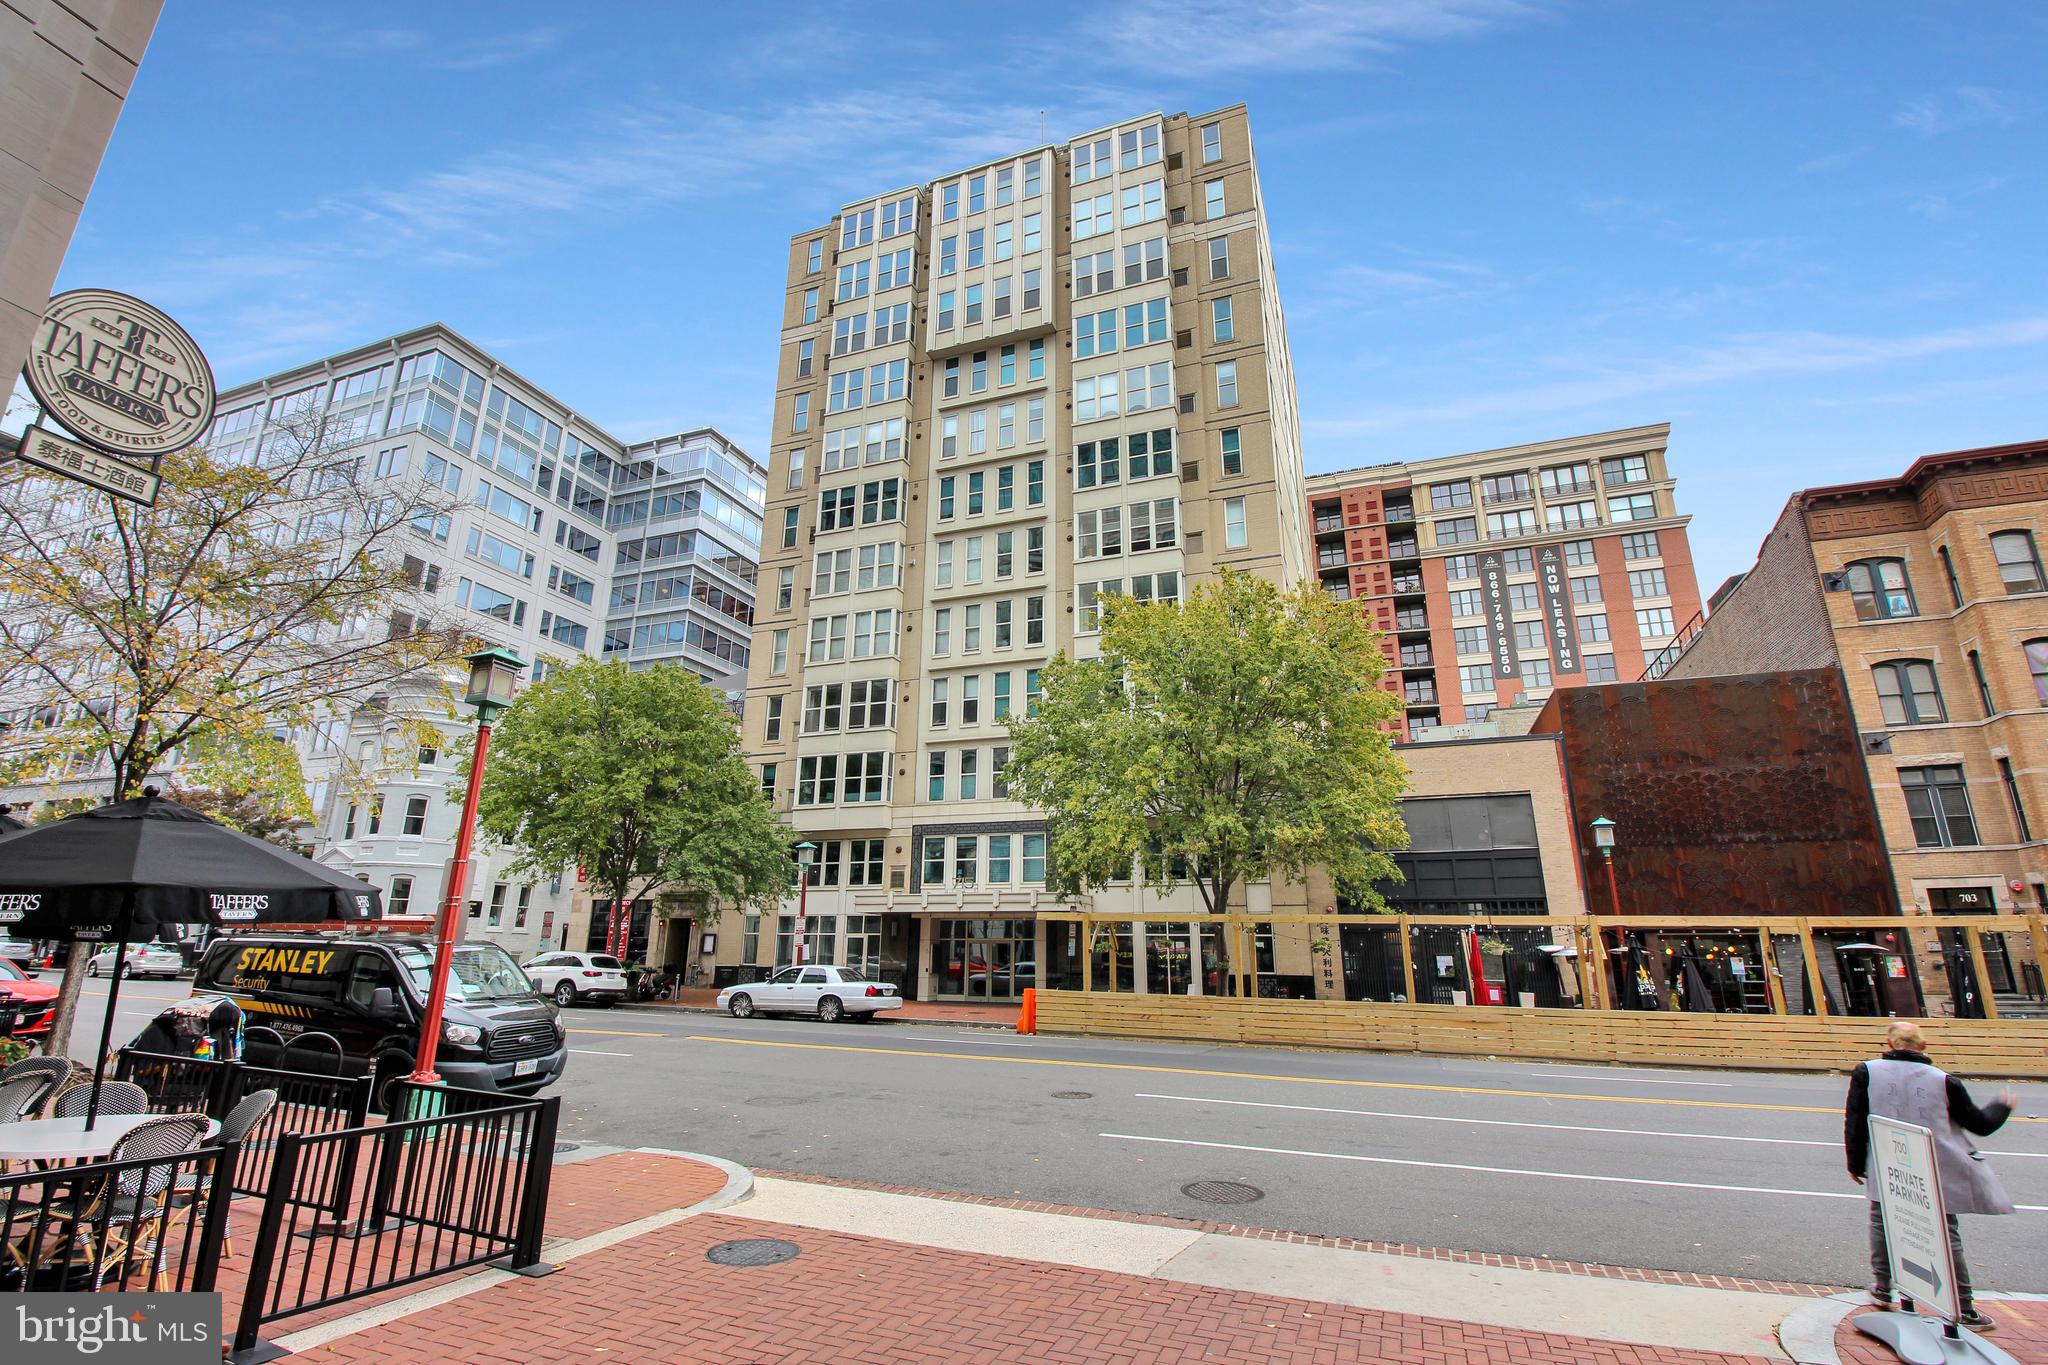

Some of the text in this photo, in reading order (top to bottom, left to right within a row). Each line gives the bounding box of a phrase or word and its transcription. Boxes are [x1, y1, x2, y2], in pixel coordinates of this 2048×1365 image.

[41, 316, 205, 419] TAFFER'S
[72, 376, 160, 424] TAVERN
[49, 390, 166, 445] FOOD & SPIRITS
[38, 439, 147, 494] 泰福士酒館
[1545, 565, 1560, 594] NOW
[1552, 598, 1573, 669] LEASING
[0, 894, 42, 911] FER'S
[210, 894, 269, 910] TAFFER'S
[1959, 893, 1978, 903] 703
[236, 947, 335, 975] STANLEY
[232, 974, 270, 993] Security
[1892, 1139, 1908, 1155] 700
[1887, 1166, 1926, 1193] PRIVATE
[1888, 1182, 1931, 1210] PARKING
